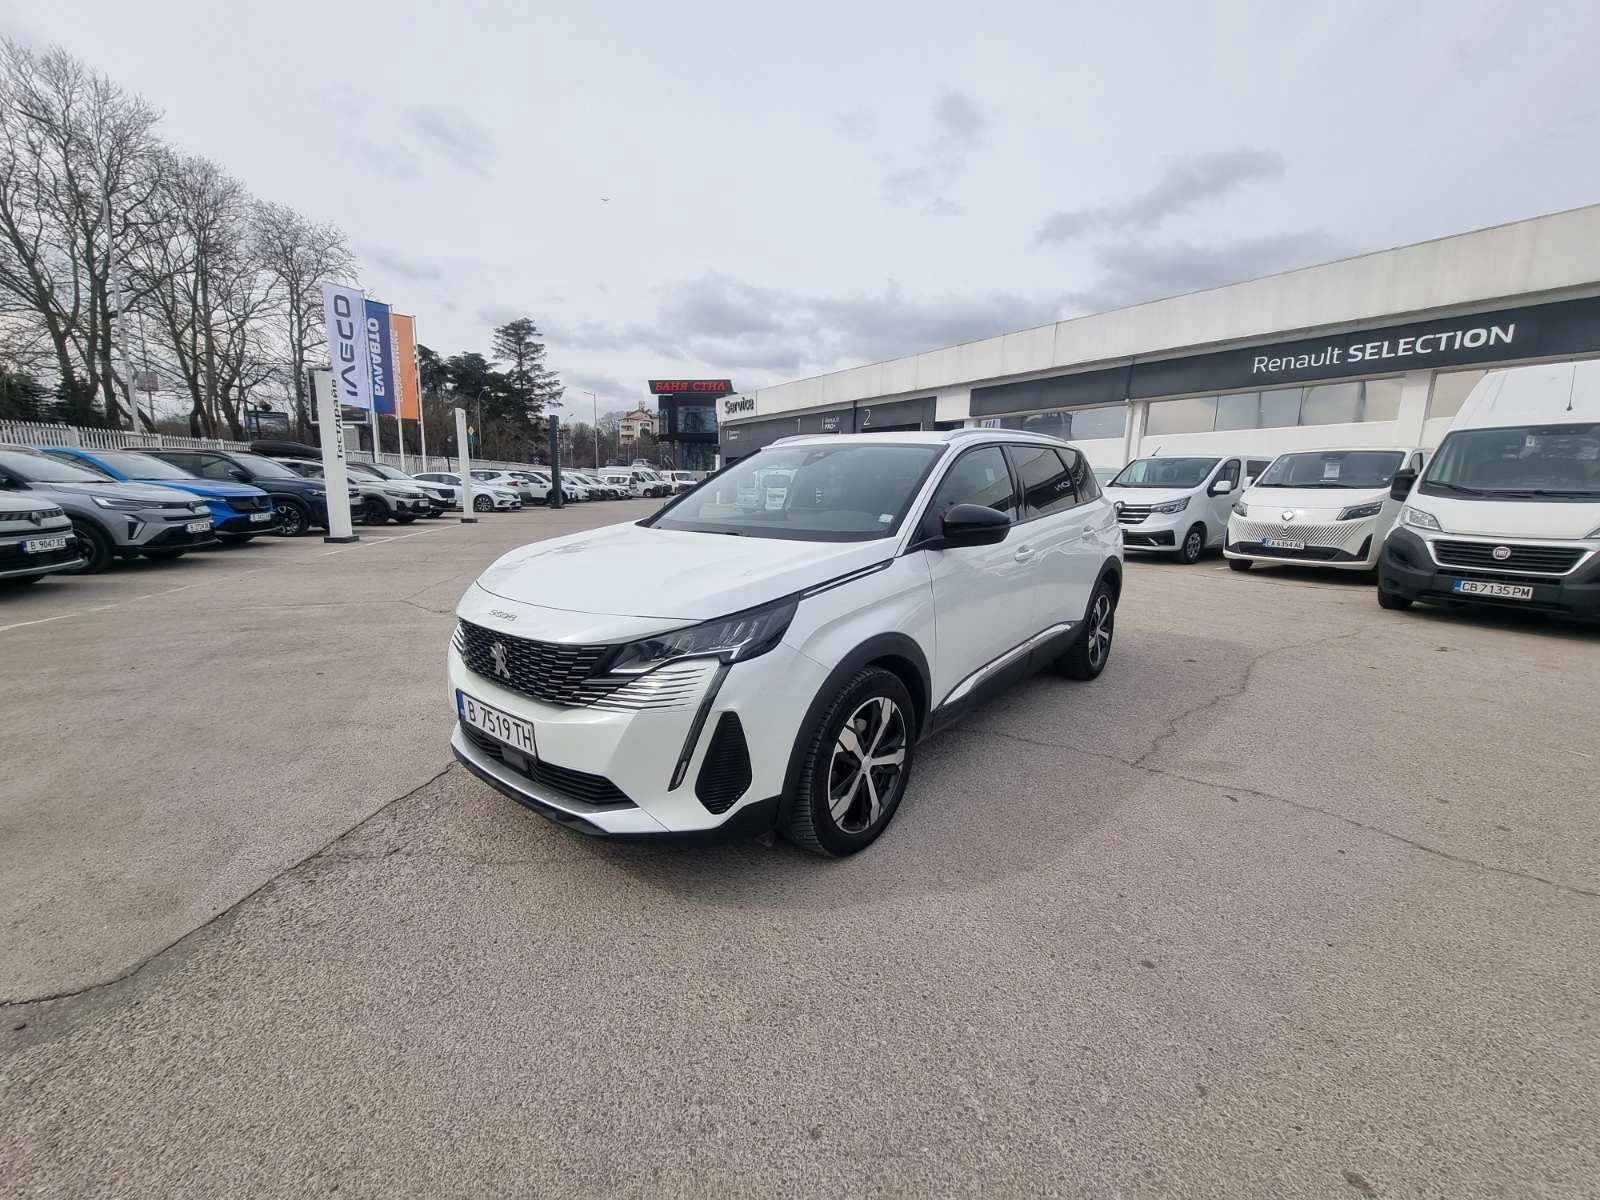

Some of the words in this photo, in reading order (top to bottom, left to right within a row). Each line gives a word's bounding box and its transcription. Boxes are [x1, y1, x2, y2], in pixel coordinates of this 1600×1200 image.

[1253, 346, 1342, 374] Renault
[1347, 322, 1516, 363] SELECTION
[724, 397, 755, 415] Service
[862, 409, 872, 426] 2
[1462, 582, 1478, 592] CB
[1480, 583, 1511, 596] 7135
[1512, 588, 1532, 598] PM
[480, 706, 511, 740] 7519
